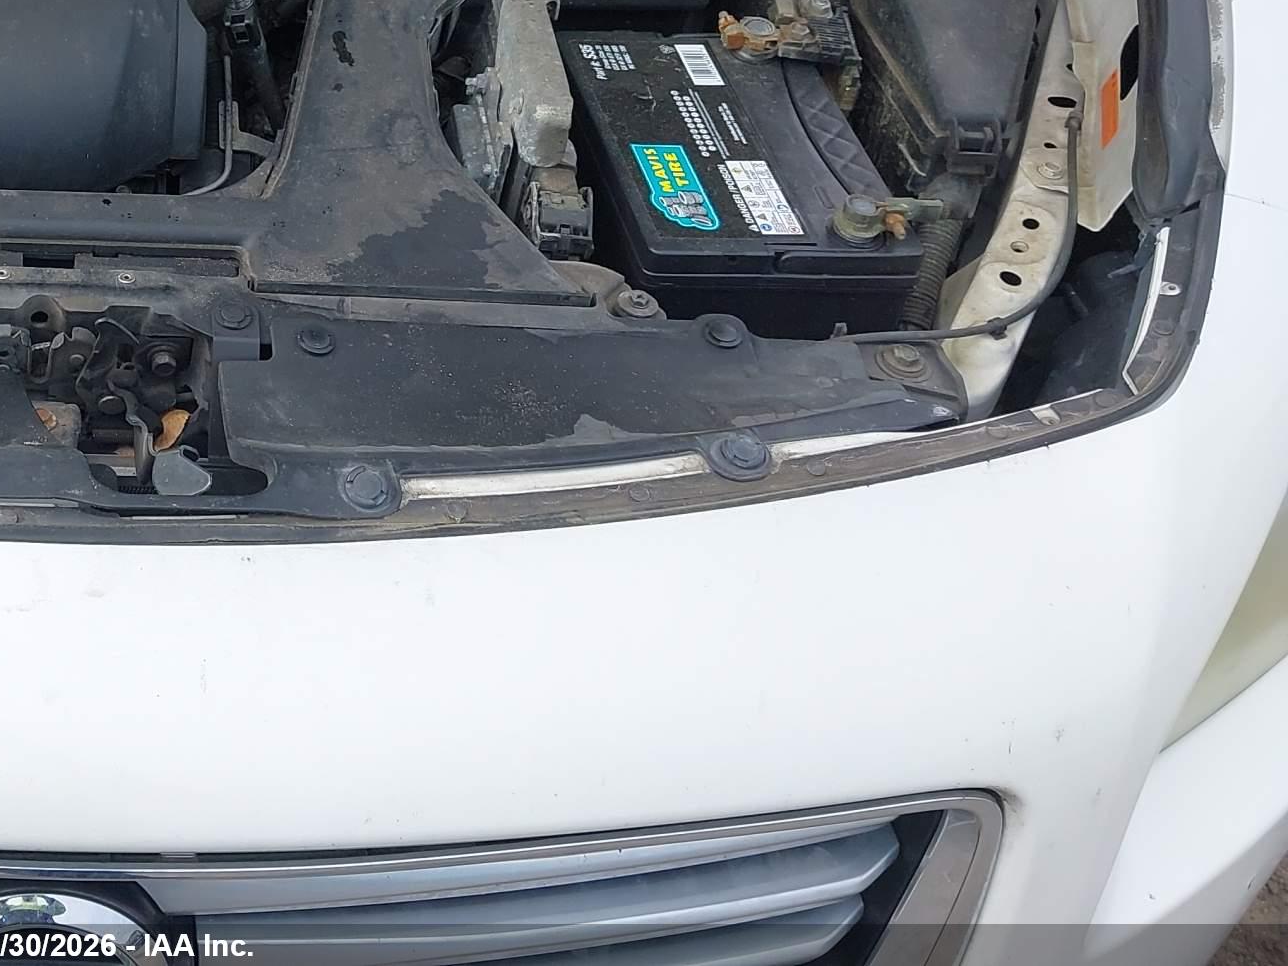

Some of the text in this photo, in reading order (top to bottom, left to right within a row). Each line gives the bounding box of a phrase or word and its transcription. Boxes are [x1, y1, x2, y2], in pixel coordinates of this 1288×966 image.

[643, 148, 675, 192] MAVIS
[663, 152, 689, 186] TIRE
[732, 194, 755, 224] DANGER
